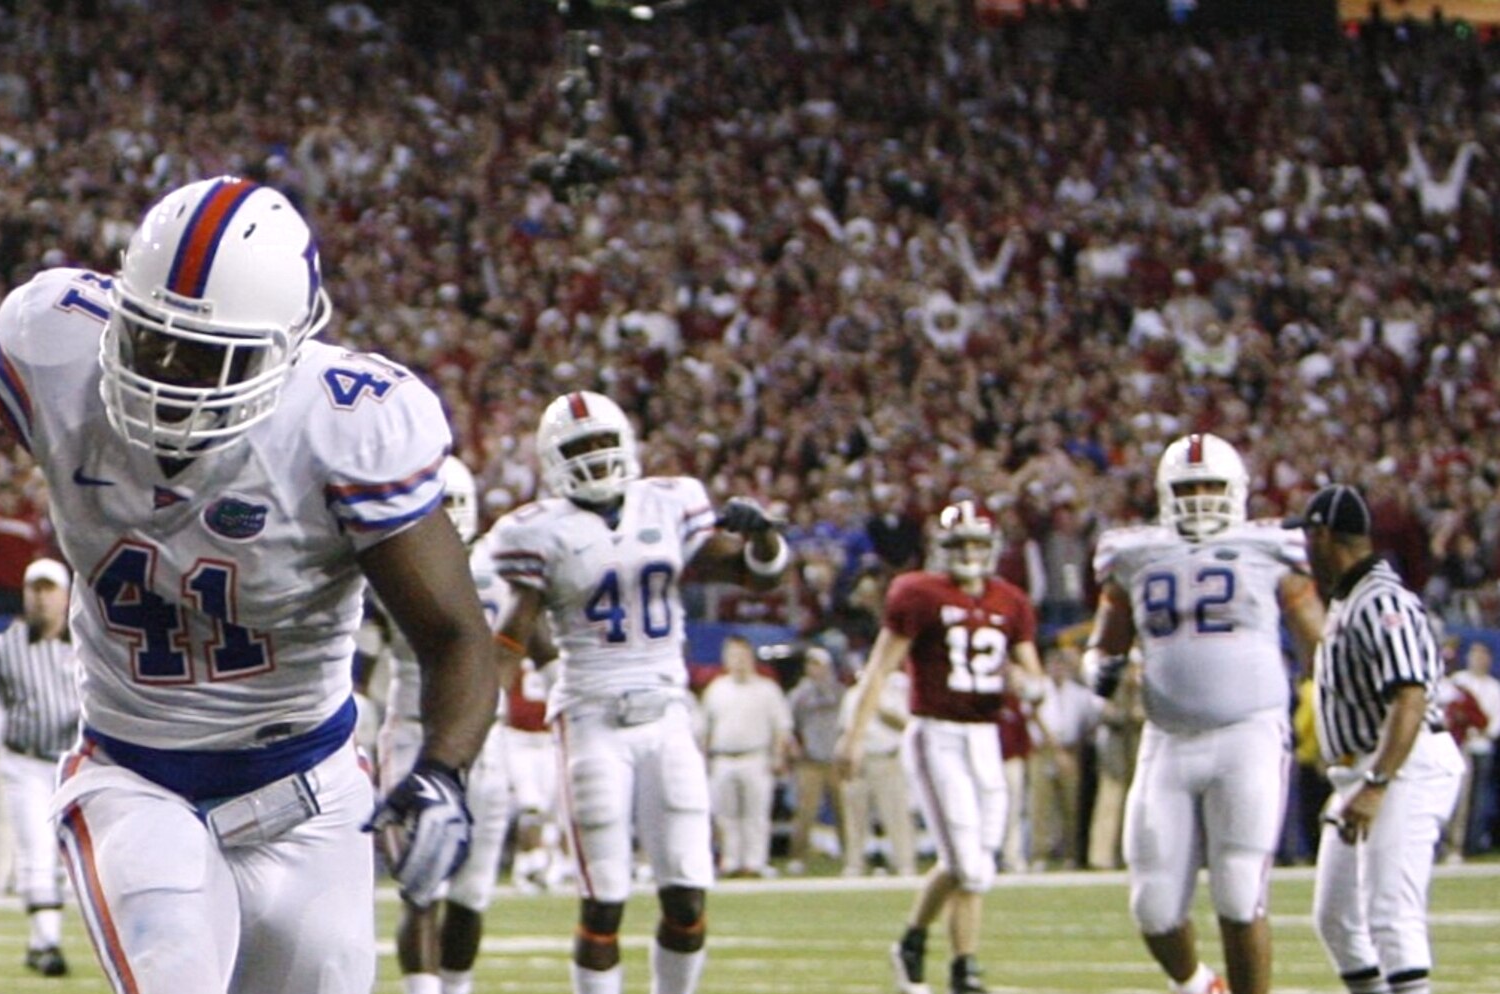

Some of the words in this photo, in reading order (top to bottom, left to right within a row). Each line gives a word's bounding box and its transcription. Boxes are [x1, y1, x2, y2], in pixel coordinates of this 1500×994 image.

[87, 537, 276, 687] 41
[584, 560, 676, 644] 40
[944, 624, 1007, 694] 12
